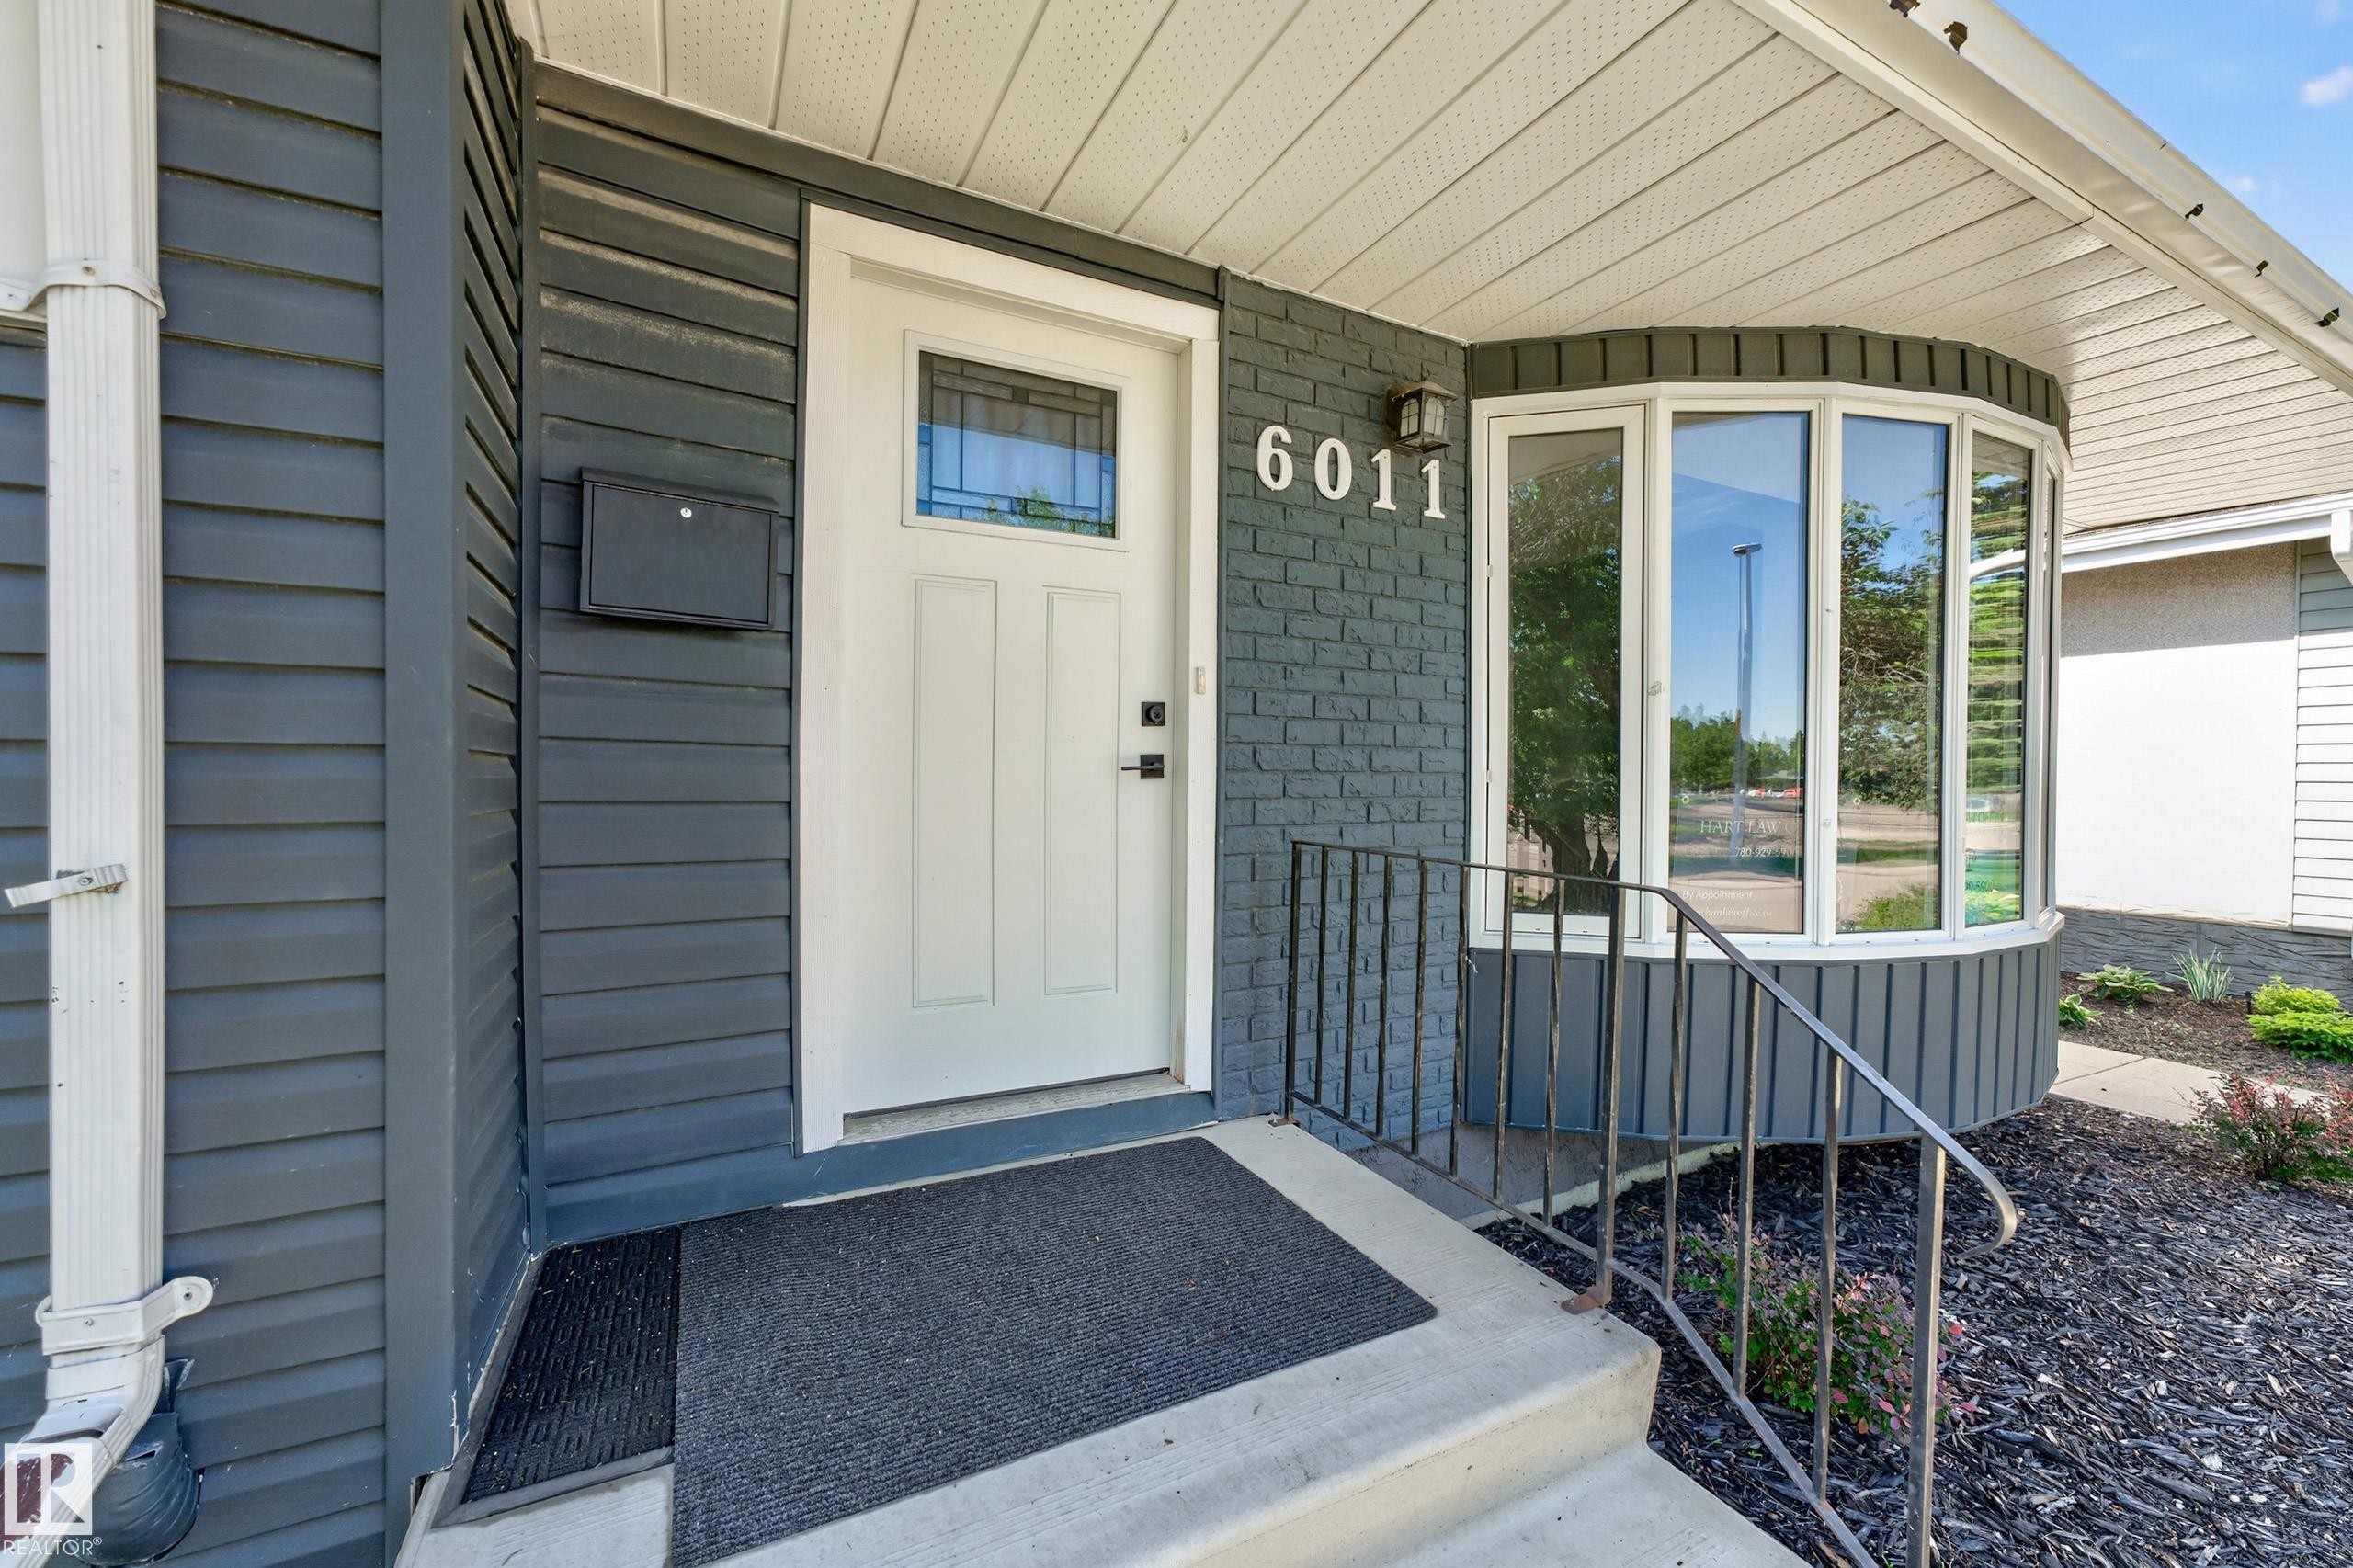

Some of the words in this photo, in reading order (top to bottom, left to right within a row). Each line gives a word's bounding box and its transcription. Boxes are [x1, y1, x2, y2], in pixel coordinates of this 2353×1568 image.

[1256, 424, 1446, 519] 6011
[1700, 820, 1745, 834] HART
[1748, 820, 1781, 834] LAW
[1682, 890, 1694, 901] By
[1696, 890, 1753, 901] Appointment
